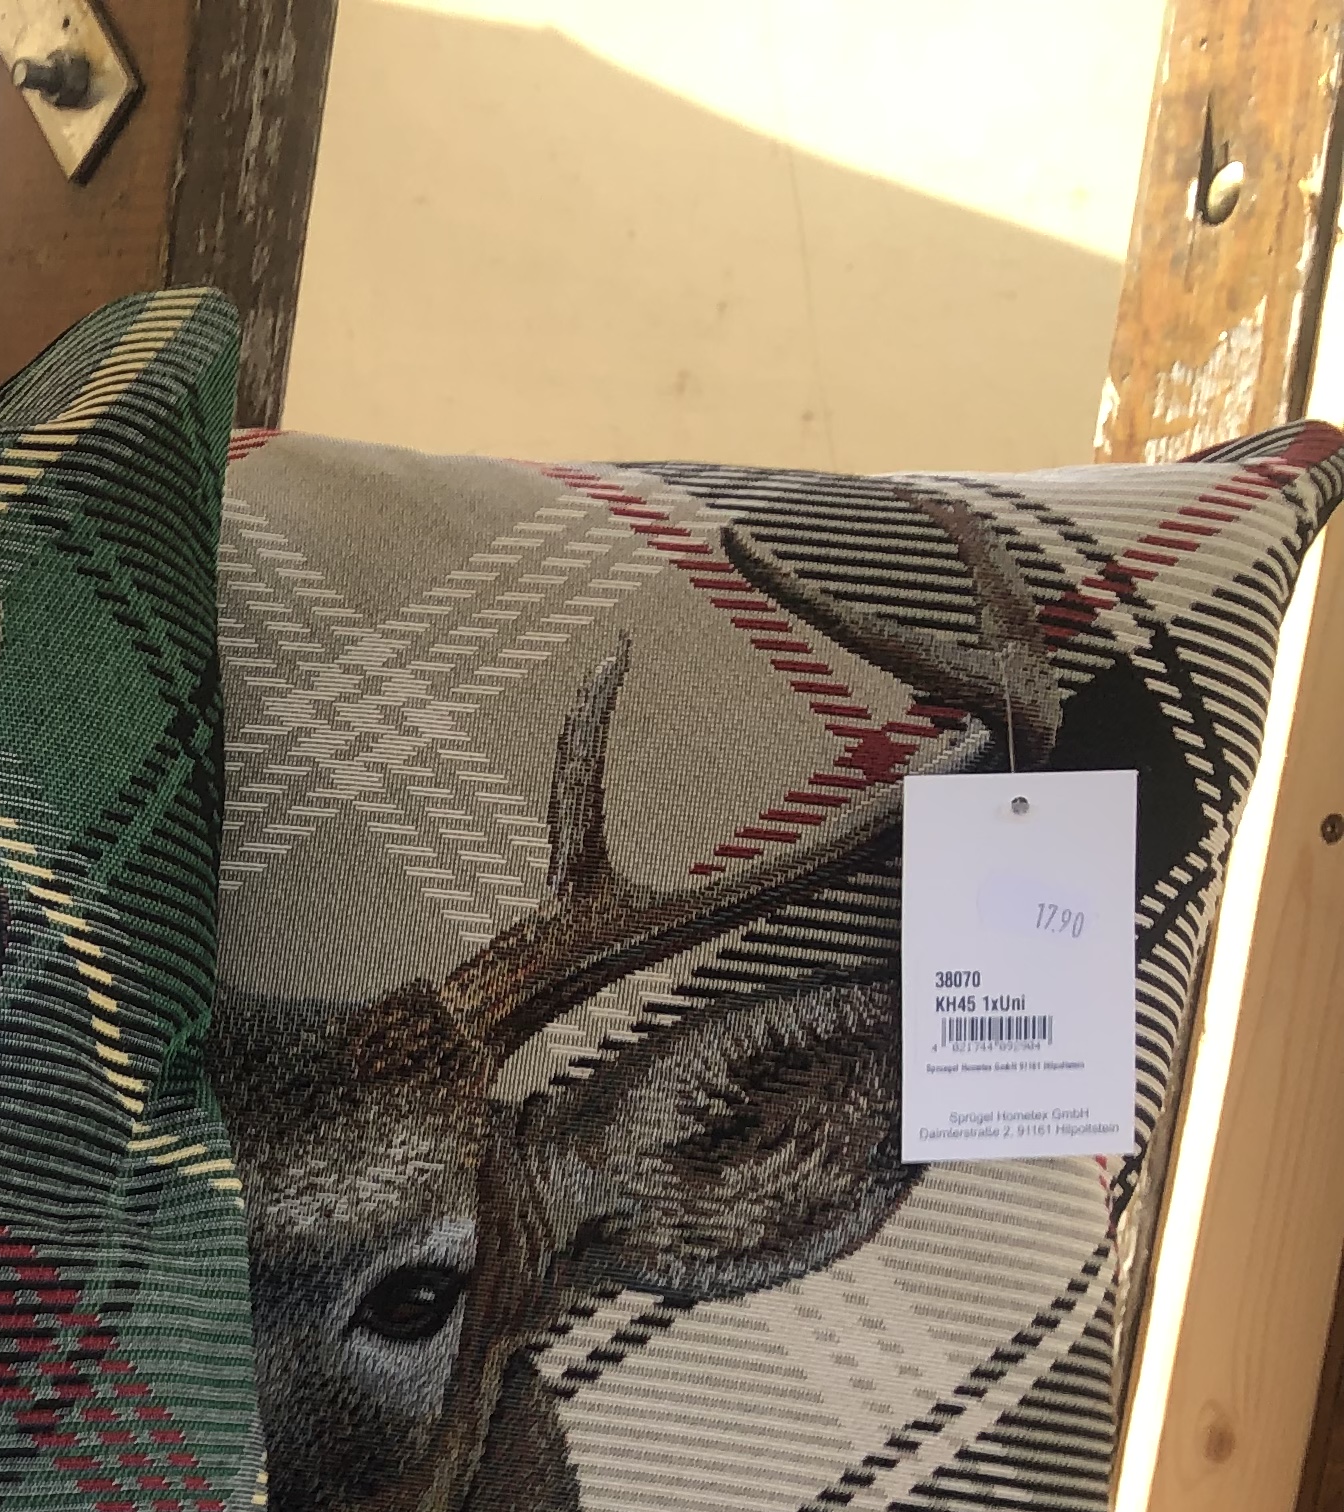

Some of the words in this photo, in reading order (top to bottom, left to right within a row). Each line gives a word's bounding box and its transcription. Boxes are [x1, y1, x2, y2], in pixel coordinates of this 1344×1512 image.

[1036, 902, 1085, 939] 17.90
[934, 970, 982, 989] 38070
[934, 995, 977, 1014] KH45
[983, 993, 1026, 1013] 1xUni
[1051, 1107, 1090, 1120] GmbH
[1017, 1124, 1052, 1138] 91161
